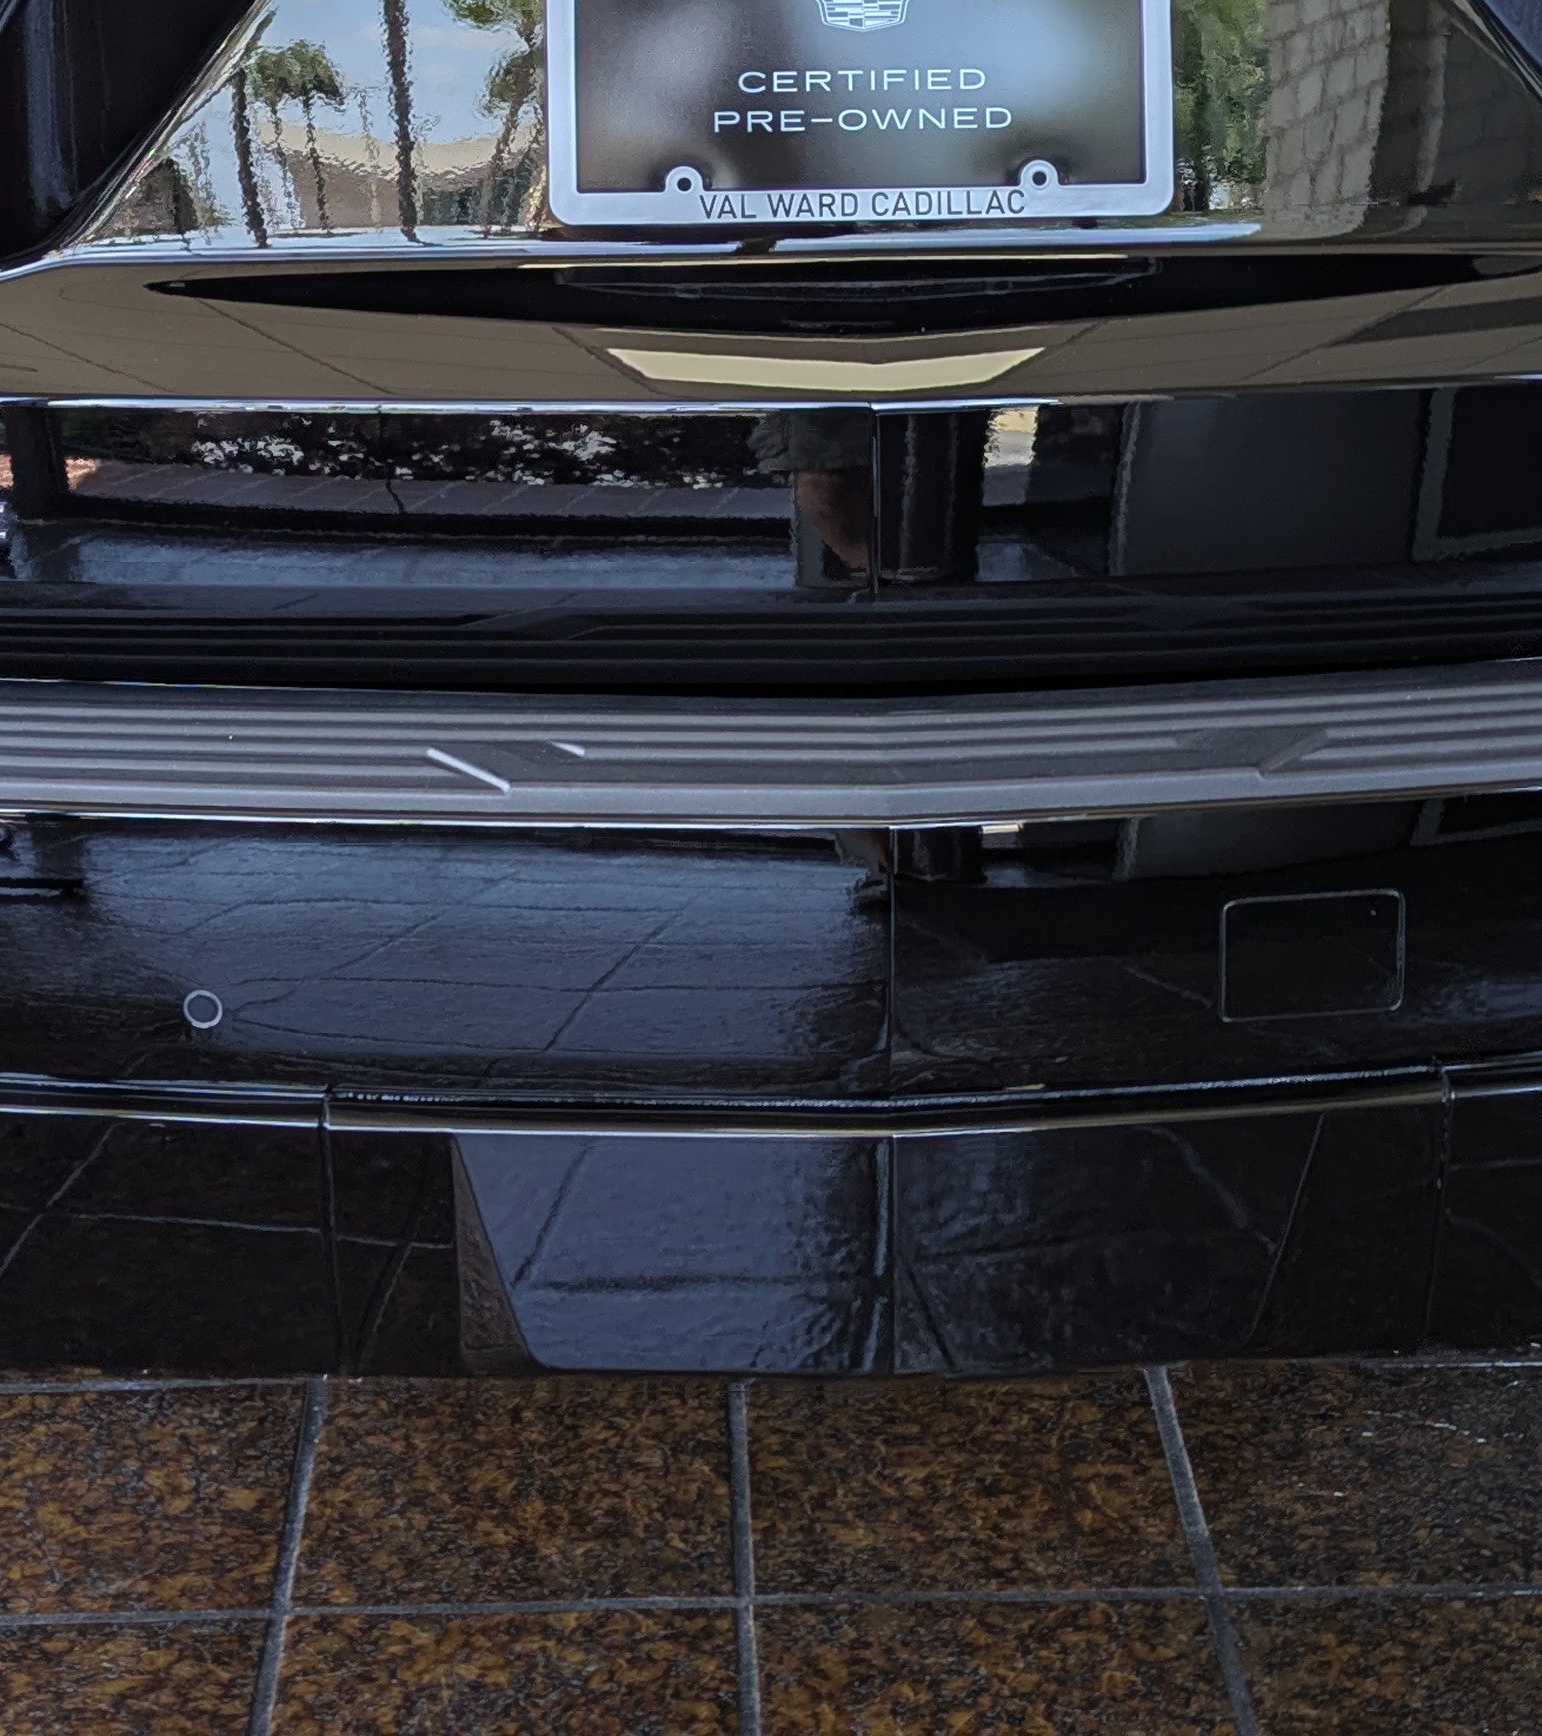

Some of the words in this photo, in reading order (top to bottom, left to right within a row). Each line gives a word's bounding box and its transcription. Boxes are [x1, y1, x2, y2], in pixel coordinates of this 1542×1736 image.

[737, 68, 987, 94] CERTIFIED
[713, 107, 1013, 134] PRE-OWNED
[698, 195, 757, 219] VAL
[766, 193, 859, 218] WARD
[870, 188, 1027, 217] CADILLAC
